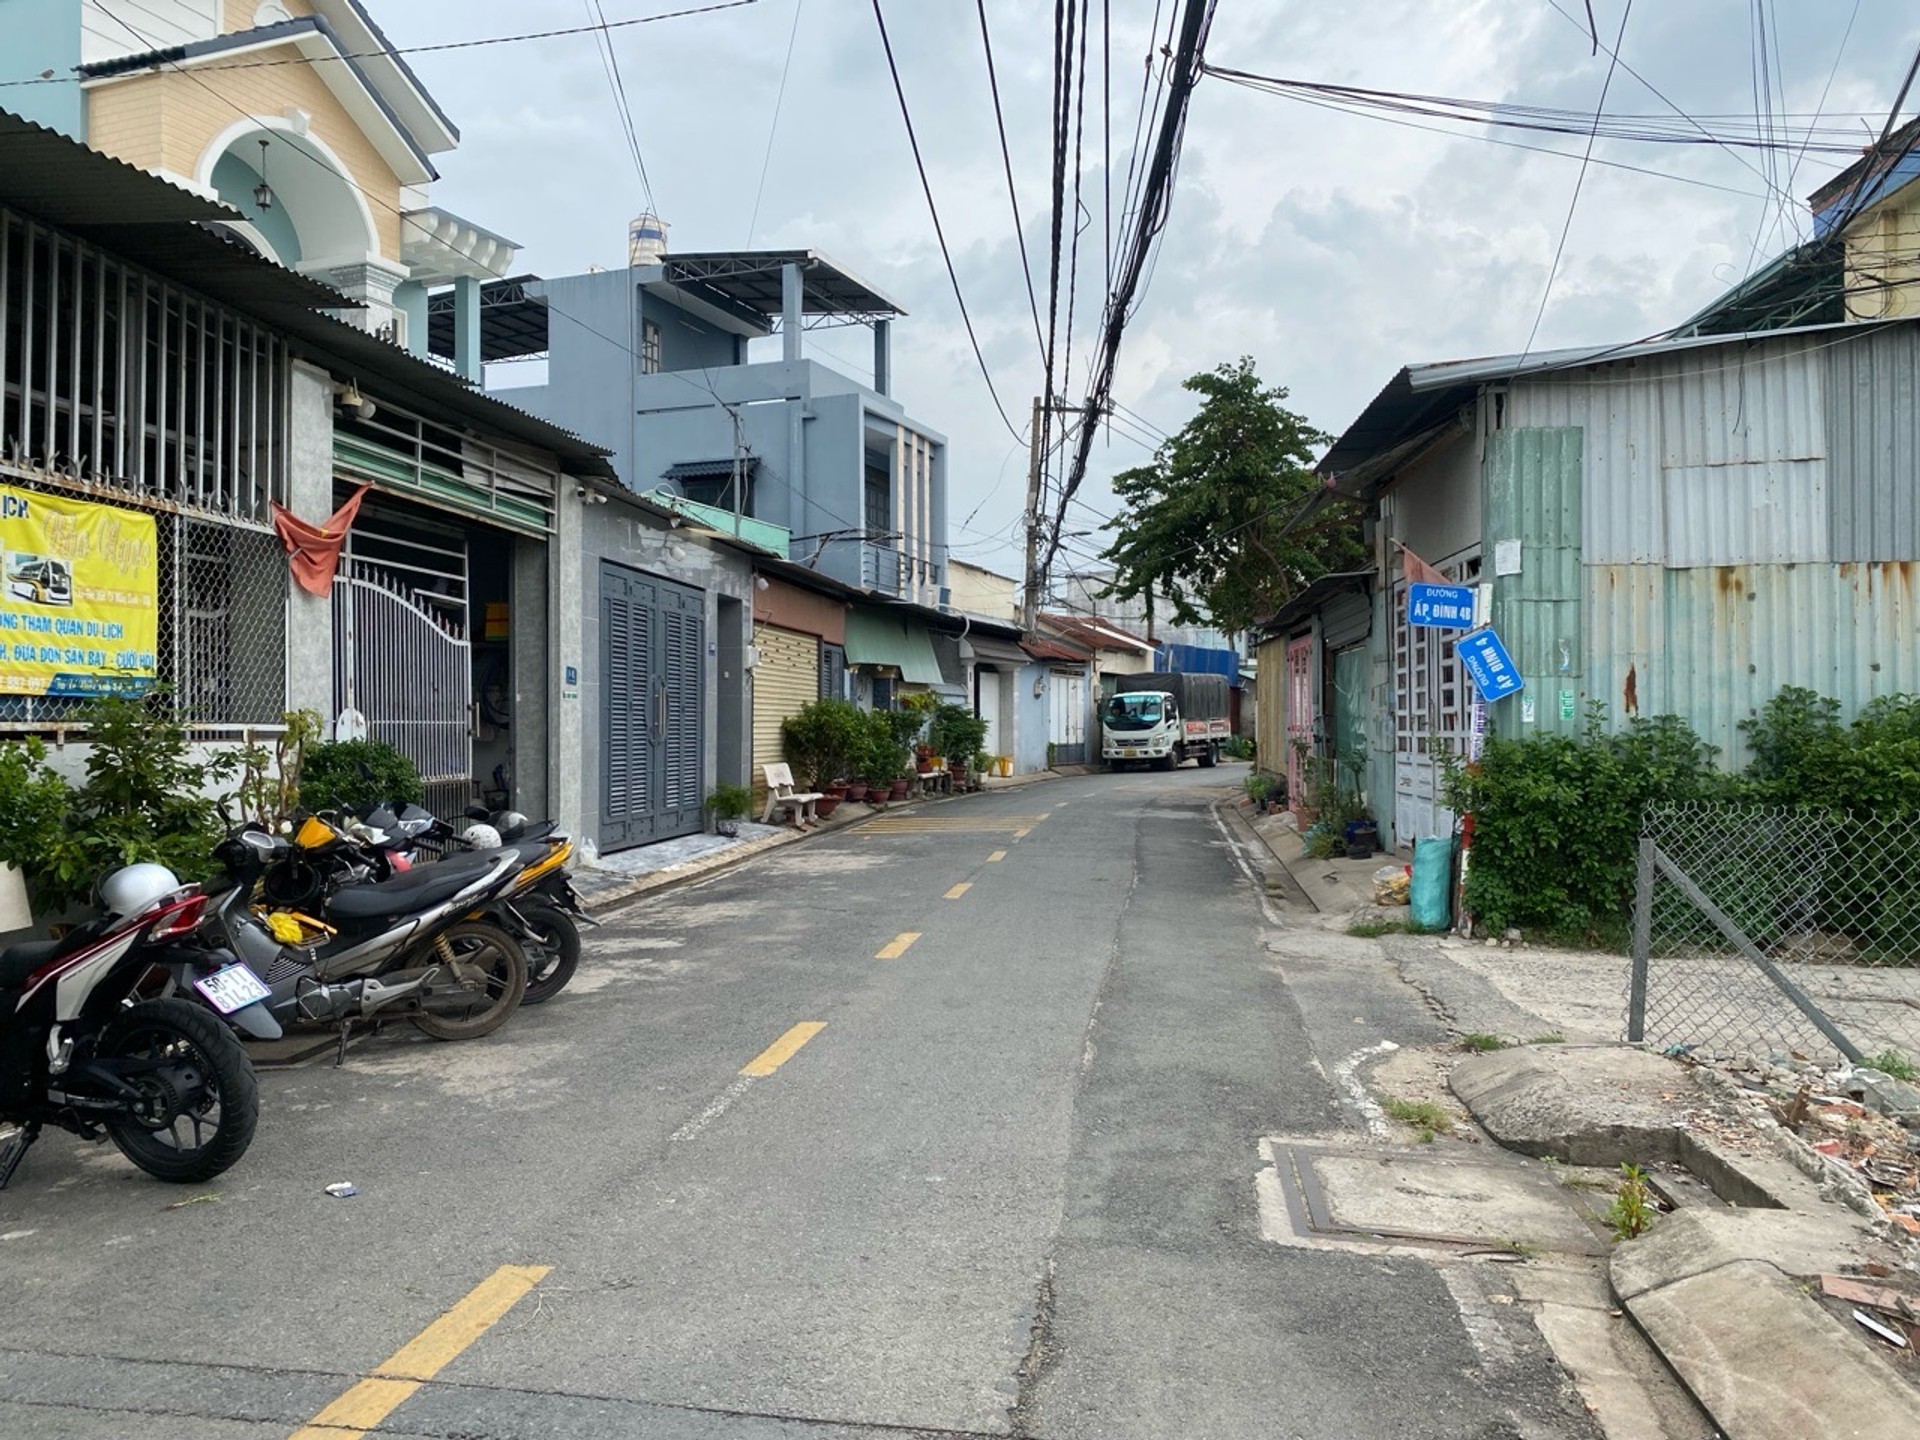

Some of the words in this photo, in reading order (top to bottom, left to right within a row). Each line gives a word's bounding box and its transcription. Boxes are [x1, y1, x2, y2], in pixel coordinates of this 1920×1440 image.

[1426, 588, 1458, 599] ĐƯỜNG
[1414, 598, 1429, 616] ẤP
[1433, 602, 1457, 619] ĐÌNH
[1459, 606, 1471, 620] 4B
[21, 615, 52, 632] THAM
[55, 618, 83, 636] QUAN
[87, 622, 98, 637] DU
[102, 623, 123, 641] LỊCH
[1475, 637, 1488, 646] 4
[88, 651, 106, 667] BAY
[1481, 646, 1505, 673] ĐÌNH
[1467, 655, 1490, 686] ĐƯỜNG
[1495, 674, 1515, 690] ẤP
[203, 970, 247, 993] 50-Y1
[216, 981, 264, 1009] 814.23
